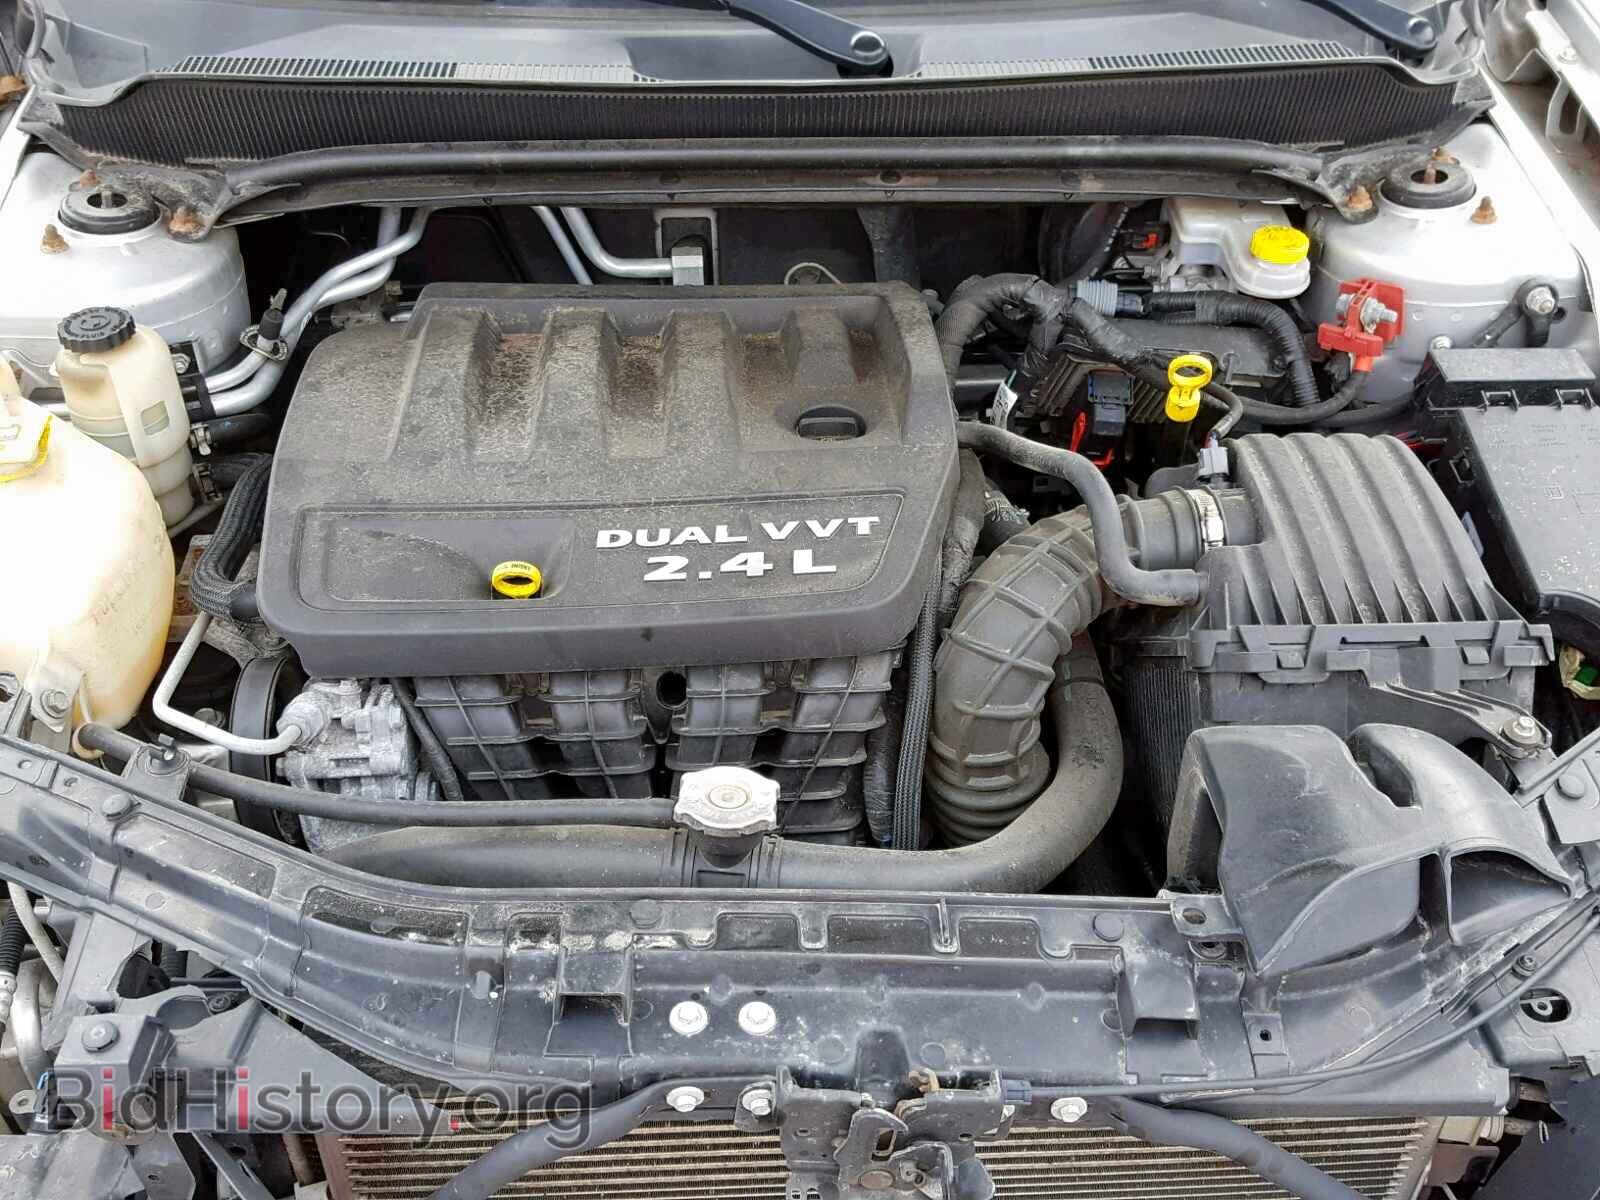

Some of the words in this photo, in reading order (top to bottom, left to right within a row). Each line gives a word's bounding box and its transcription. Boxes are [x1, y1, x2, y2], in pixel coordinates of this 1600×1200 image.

[596, 525, 748, 548] DUAL
[761, 516, 880, 540] VVT
[643, 551, 774, 581] 2.4
[792, 549, 837, 574] L
